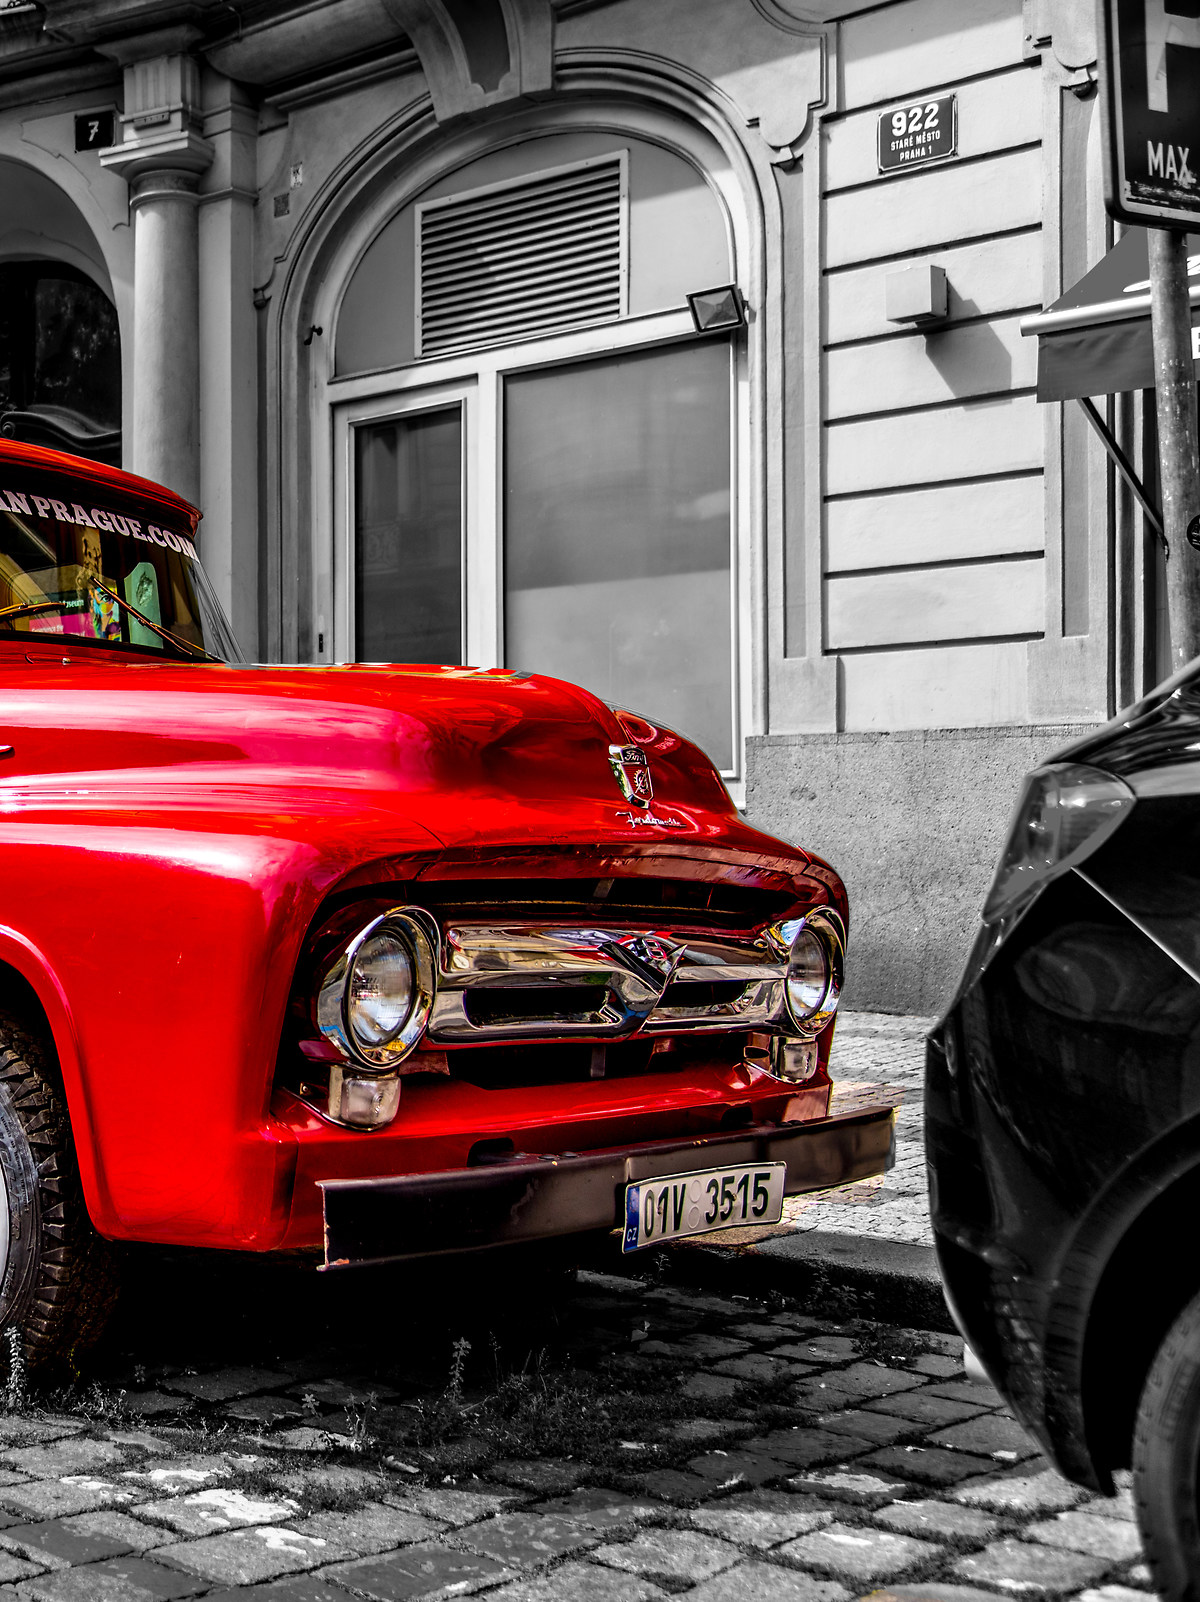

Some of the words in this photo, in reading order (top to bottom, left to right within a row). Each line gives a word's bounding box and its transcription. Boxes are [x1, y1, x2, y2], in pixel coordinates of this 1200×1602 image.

[891, 103, 938, 136] 922
[88, 121, 100, 142] 7
[891, 135, 913, 150] STARÉ
[916, 130, 940, 145] MĚSTO
[900, 147, 925, 161] PRAHA
[928, 145, 932, 154] 1
[704, 1172, 771, 1225] 3515
[626, 1226, 637, 1242] CZ
